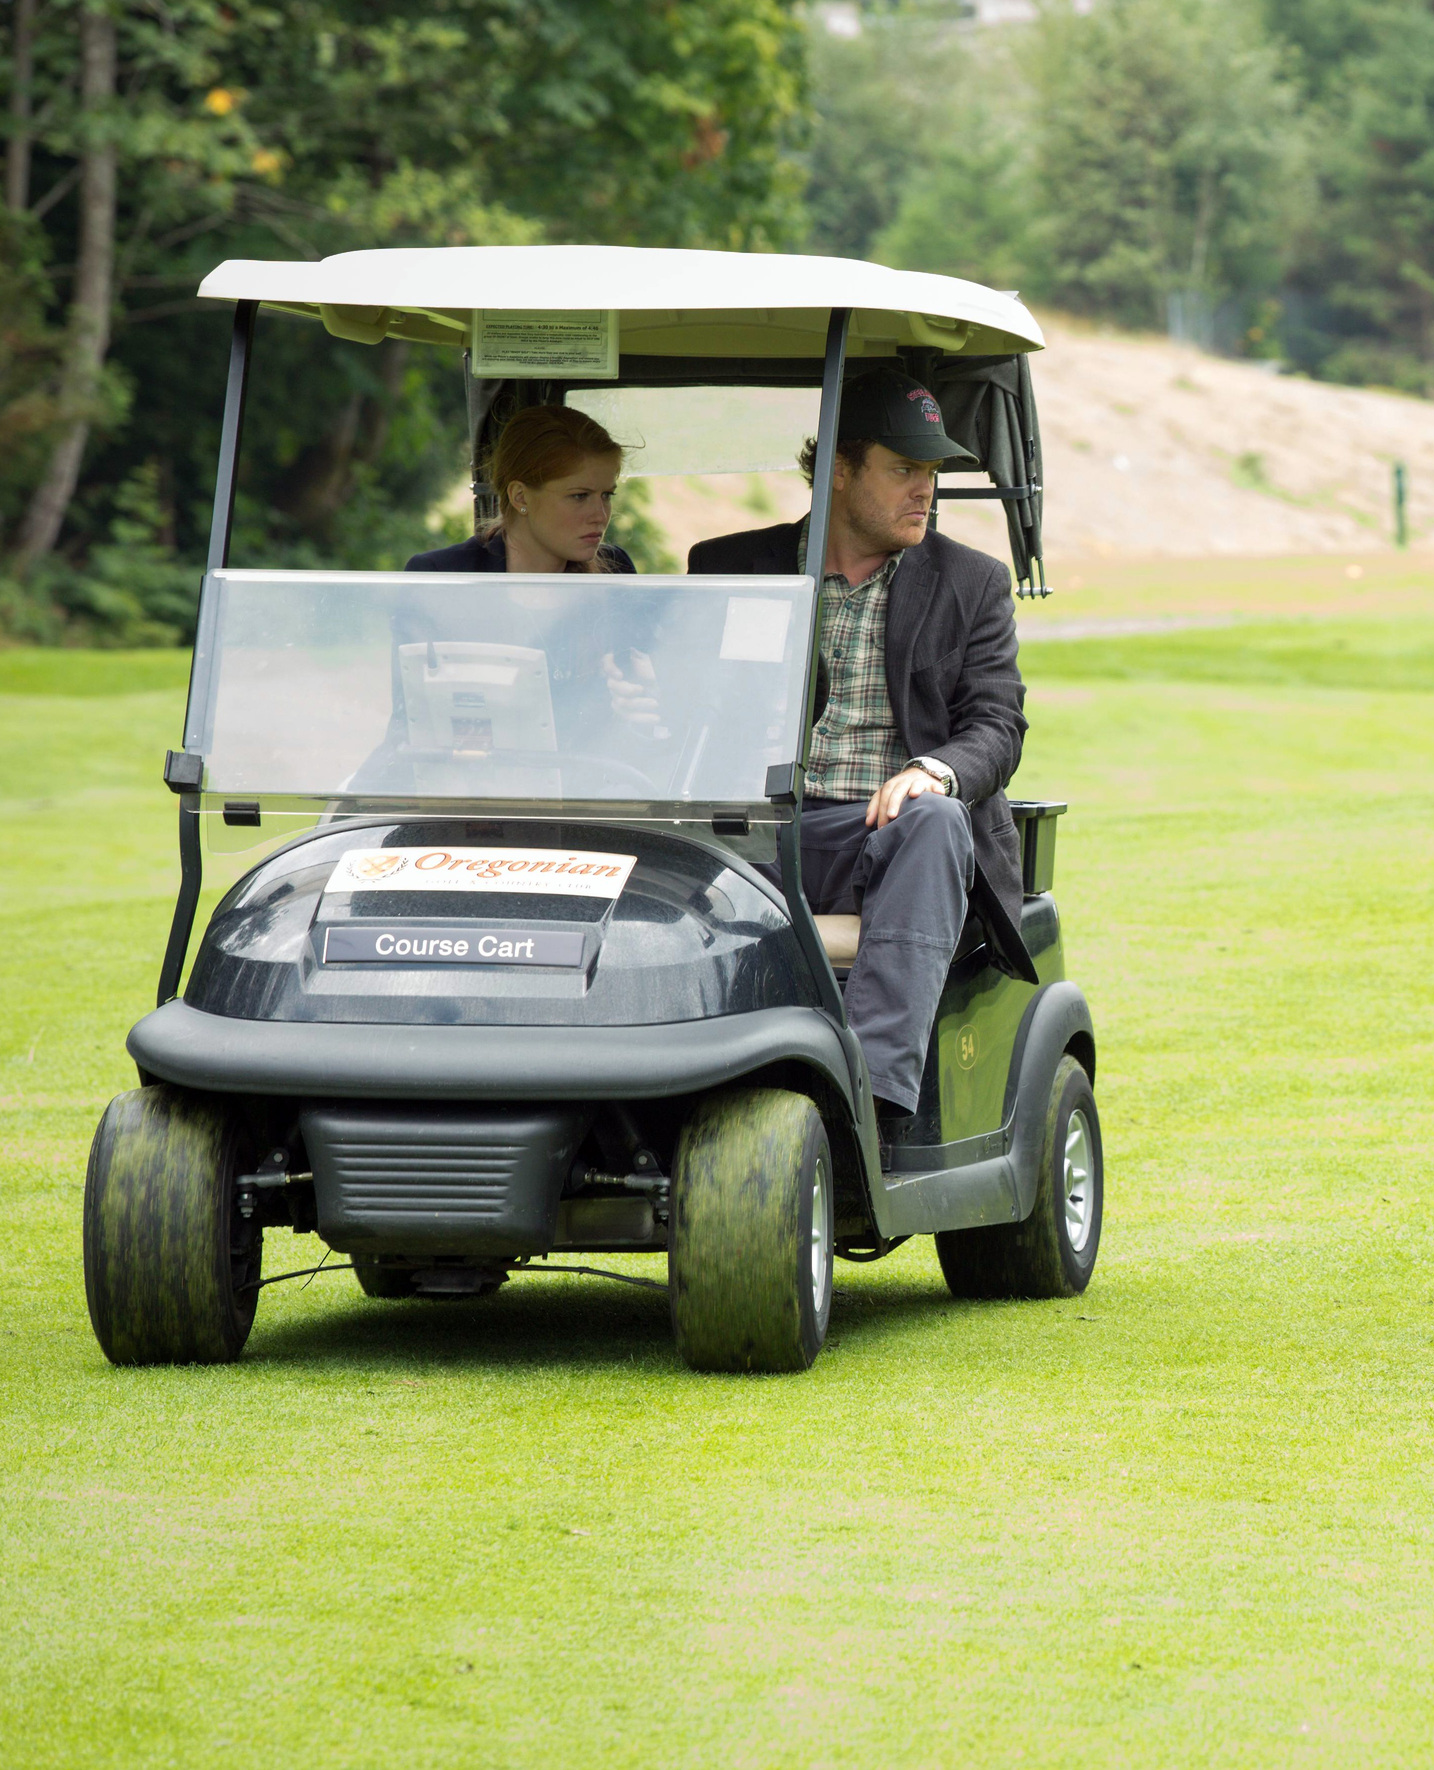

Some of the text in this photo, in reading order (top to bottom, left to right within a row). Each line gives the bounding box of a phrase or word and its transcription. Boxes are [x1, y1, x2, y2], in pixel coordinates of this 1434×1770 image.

[415, 852, 622, 878] Oregonian
[375, 933, 534, 959] Course Cart
[961, 1033, 974, 1062] 54
